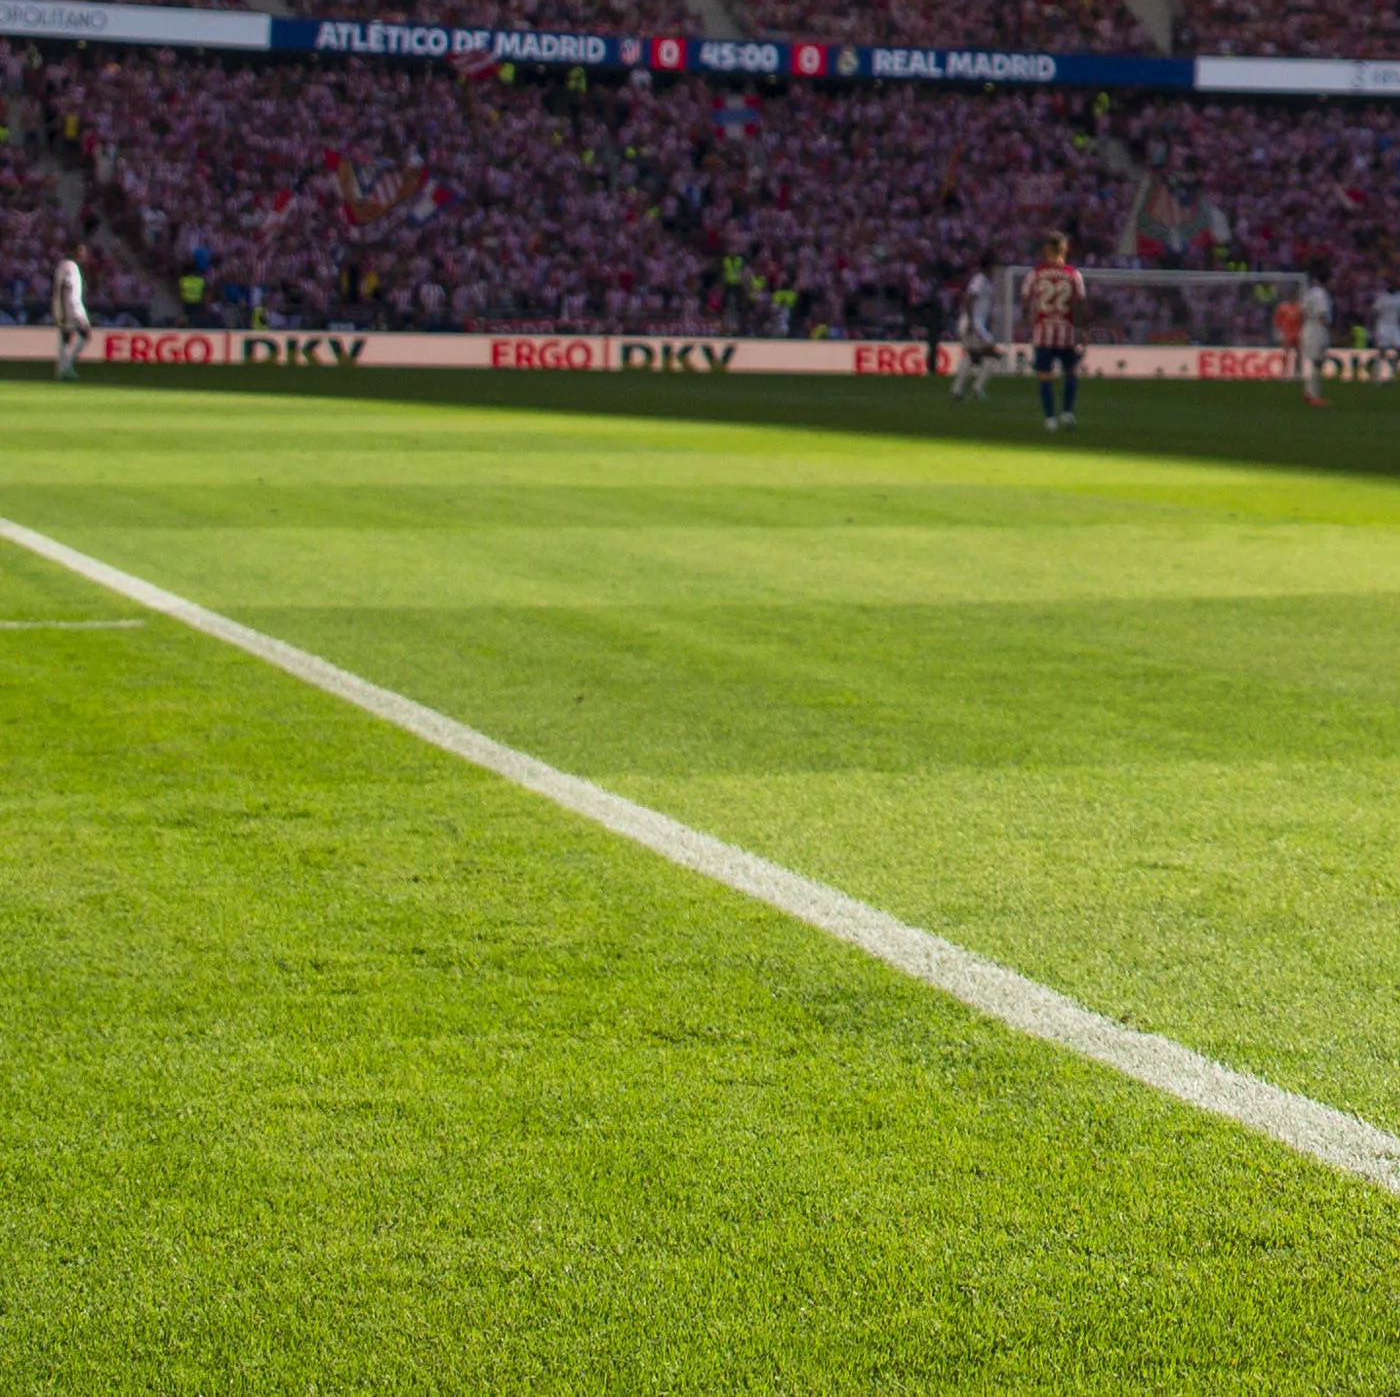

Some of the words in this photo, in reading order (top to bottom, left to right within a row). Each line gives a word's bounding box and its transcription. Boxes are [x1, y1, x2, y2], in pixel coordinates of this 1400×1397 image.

[315, 19, 448, 53] ATLÉTICO
[495, 31, 606, 63] MADRID
[658, 39, 681, 67] 0
[701, 41, 779, 71] 45:00
[873, 48, 944, 78] REAL
[945, 50, 1057, 81] MADRID
[1037, 279, 1072, 315] 22
[104, 332, 213, 365] ERGO
[242, 336, 367, 365] DKV
[490, 338, 593, 370] ERGO
[620, 342, 737, 372] DKV
